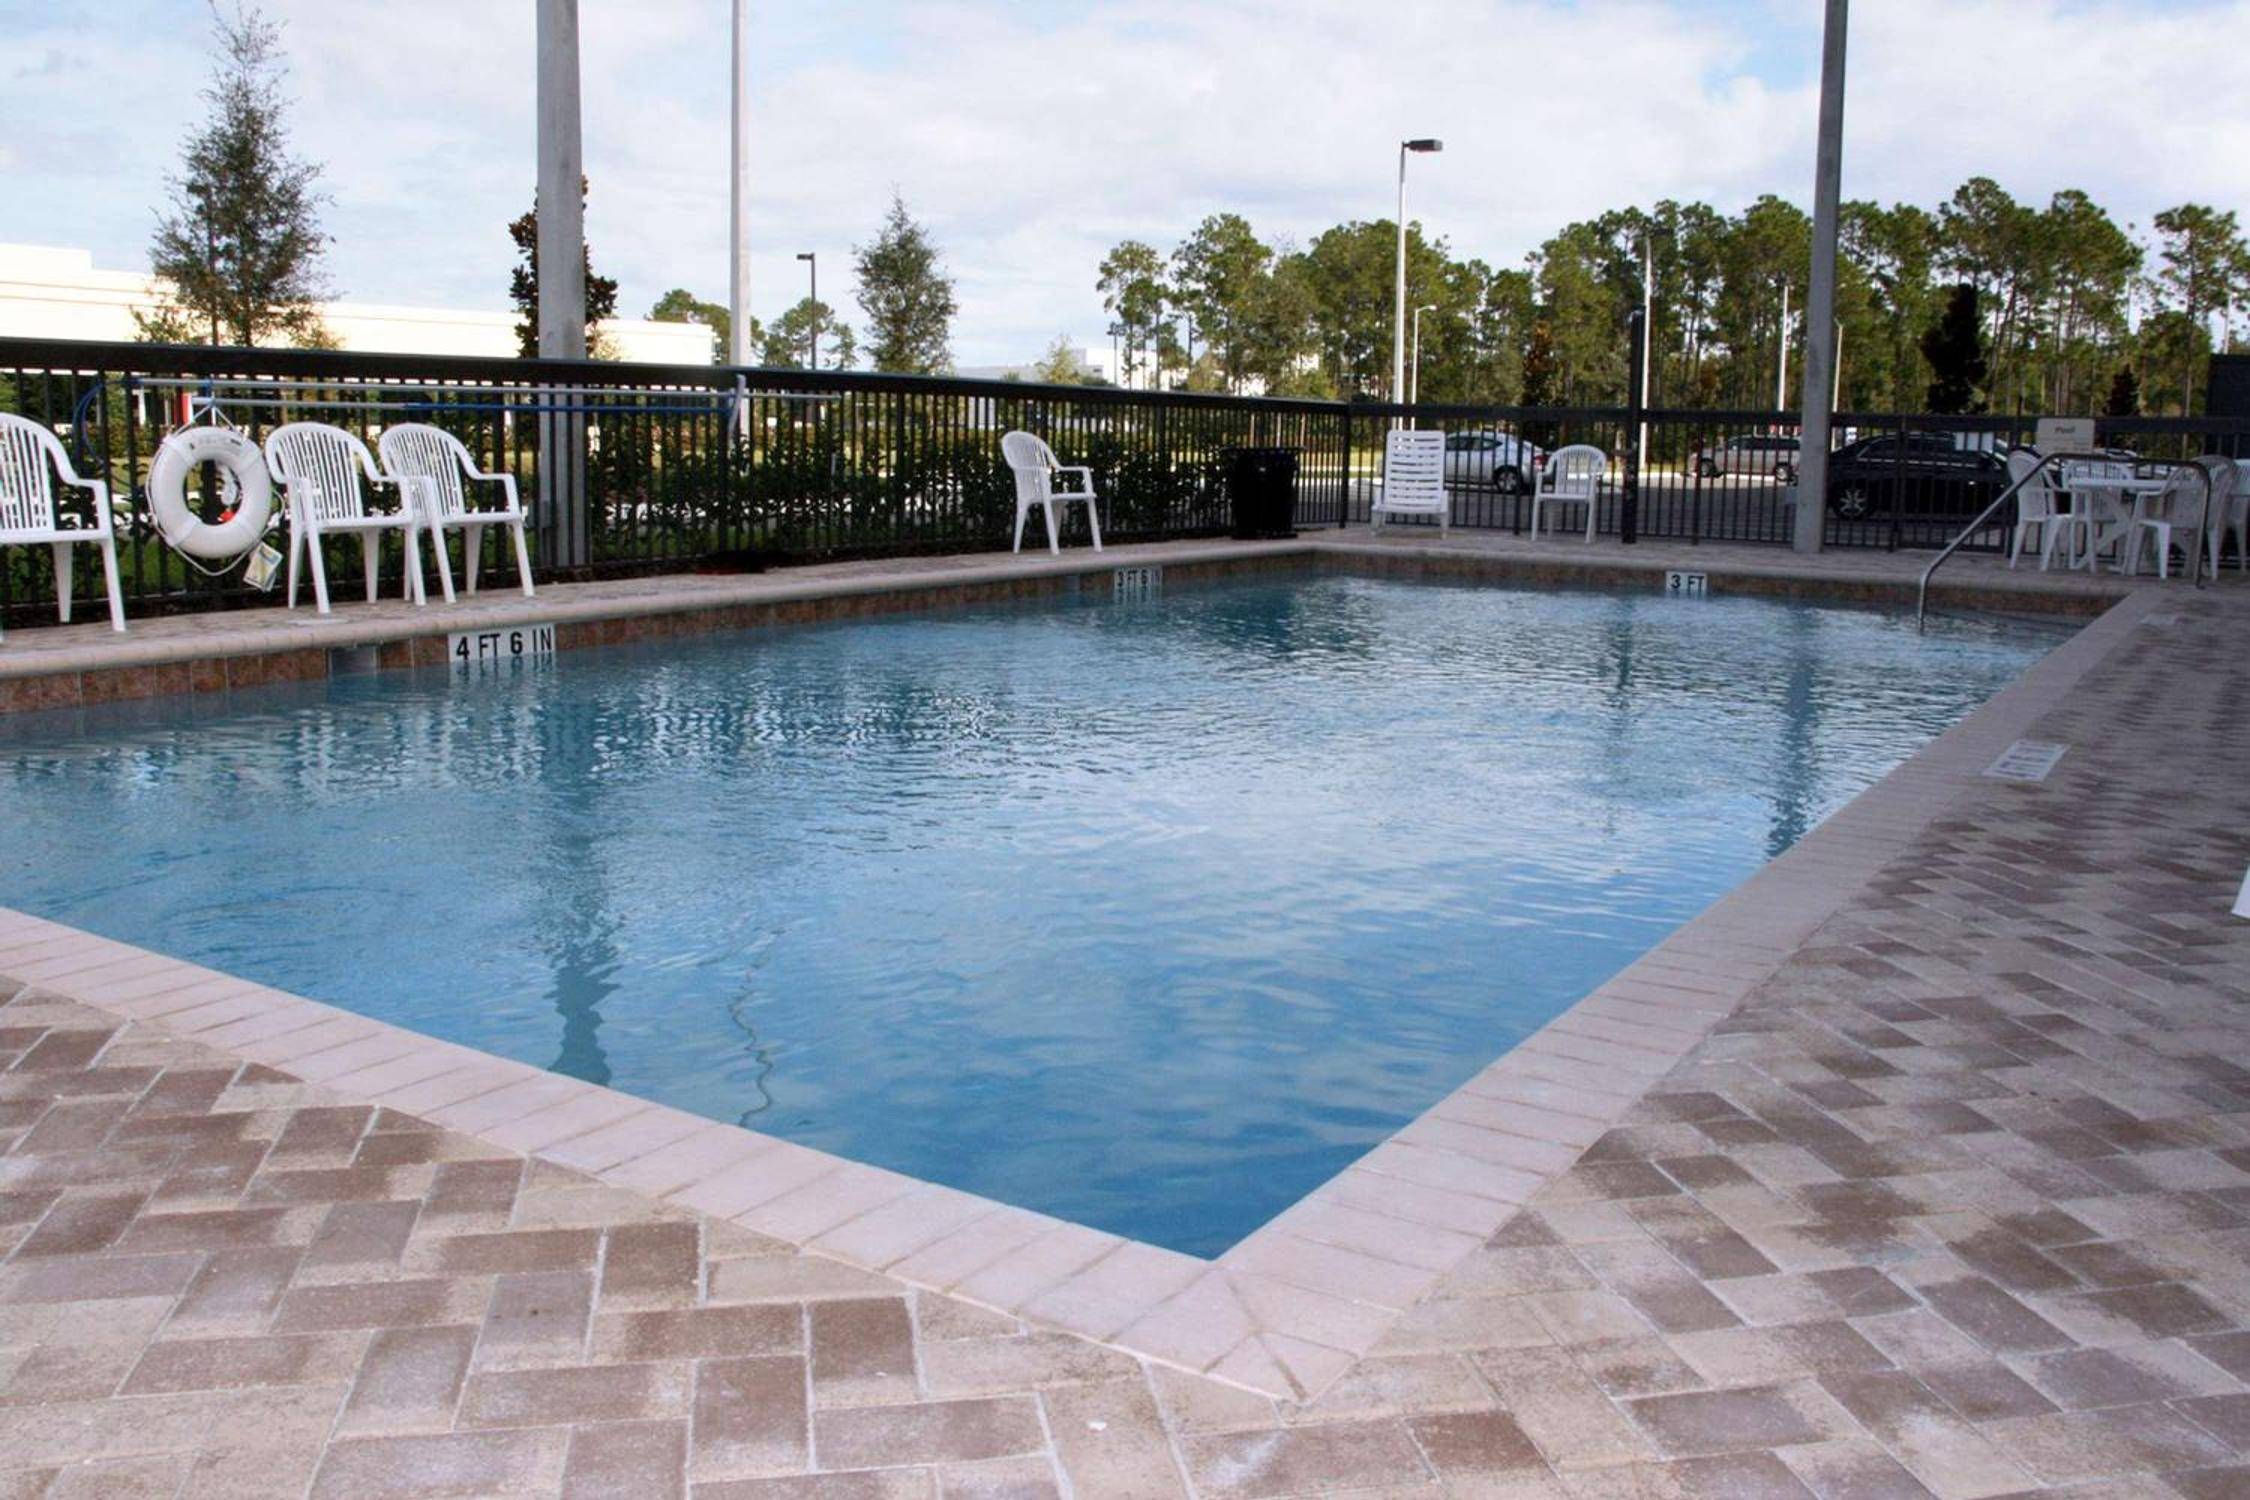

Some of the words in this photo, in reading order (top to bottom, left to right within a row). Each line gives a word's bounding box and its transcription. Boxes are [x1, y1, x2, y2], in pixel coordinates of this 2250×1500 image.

[1671, 574, 1681, 589] 3
[1687, 575, 1705, 592] FT
[456, 636, 470, 661] 4
[478, 633, 501, 659] FT
[510, 631, 523, 655] 6
[532, 627, 553, 653] IN
